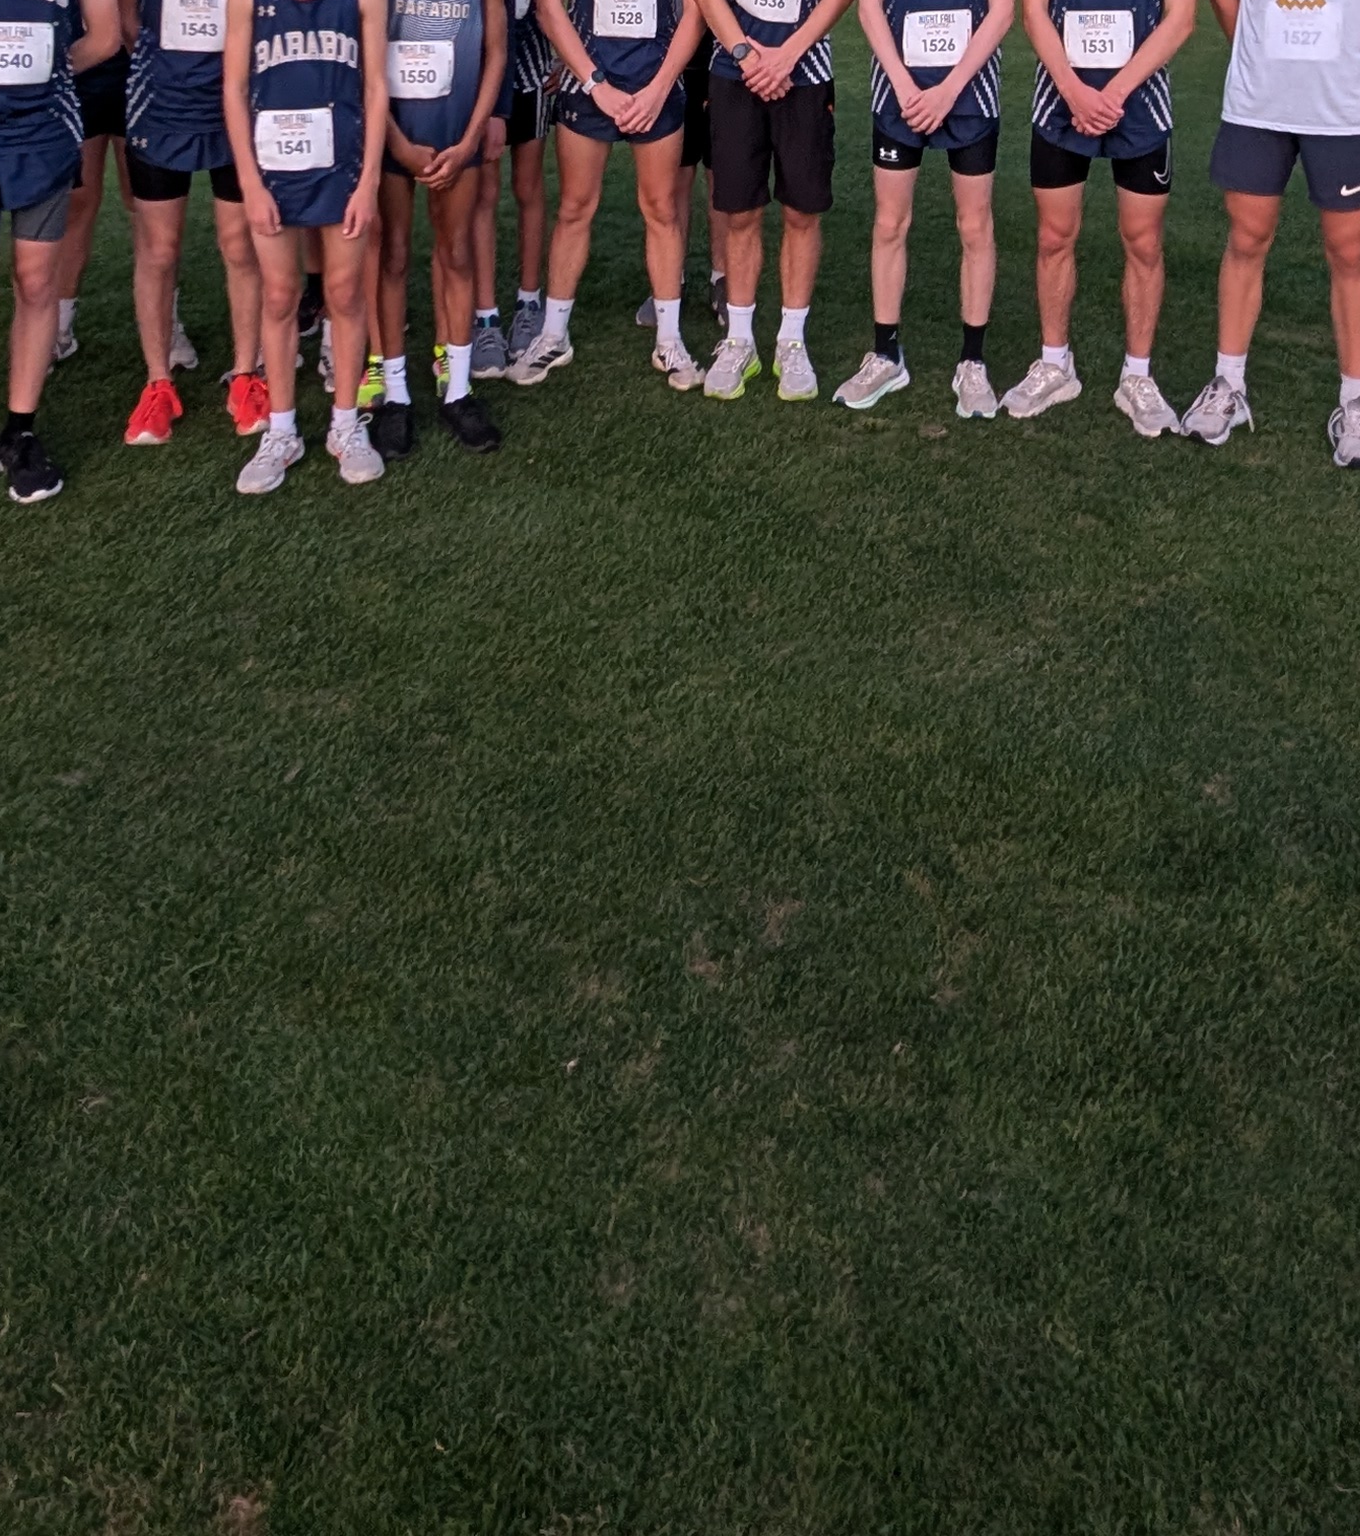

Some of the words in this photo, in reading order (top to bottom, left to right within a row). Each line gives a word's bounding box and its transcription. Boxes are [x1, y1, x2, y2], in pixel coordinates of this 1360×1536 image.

[611, 11, 643, 25] 1528
[181, 22, 218, 37] 1543
[1283, 30, 1322, 45] 1527
[922, 38, 956, 53] 1526
[1081, 39, 1114, 53] 1531
[400, 69, 437, 84] 1550
[275, 140, 312, 155] 1541
